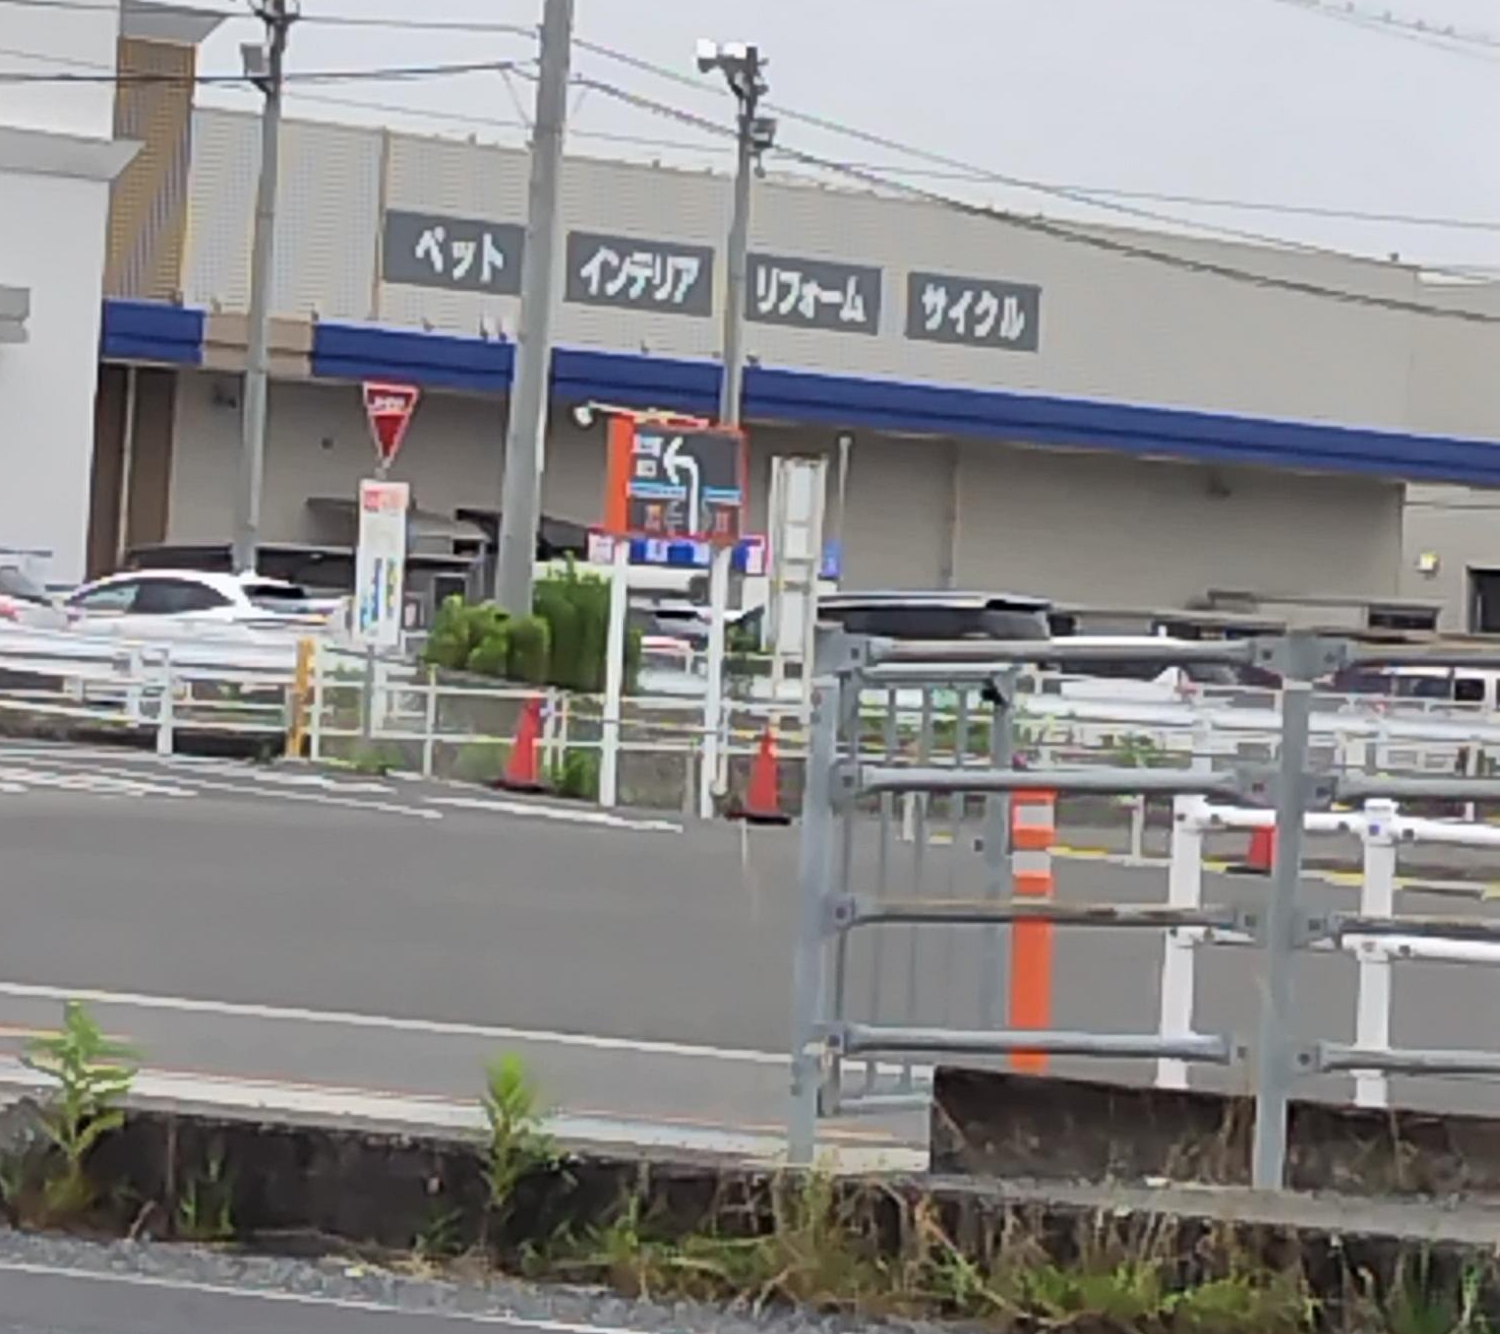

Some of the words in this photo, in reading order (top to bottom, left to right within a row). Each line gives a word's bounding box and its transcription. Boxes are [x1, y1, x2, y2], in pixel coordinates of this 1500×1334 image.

[414, 226, 505, 284] ペット
[579, 246, 701, 304] インテリア
[757, 265, 867, 323] リフォーム
[922, 283, 1026, 341] サイクル
